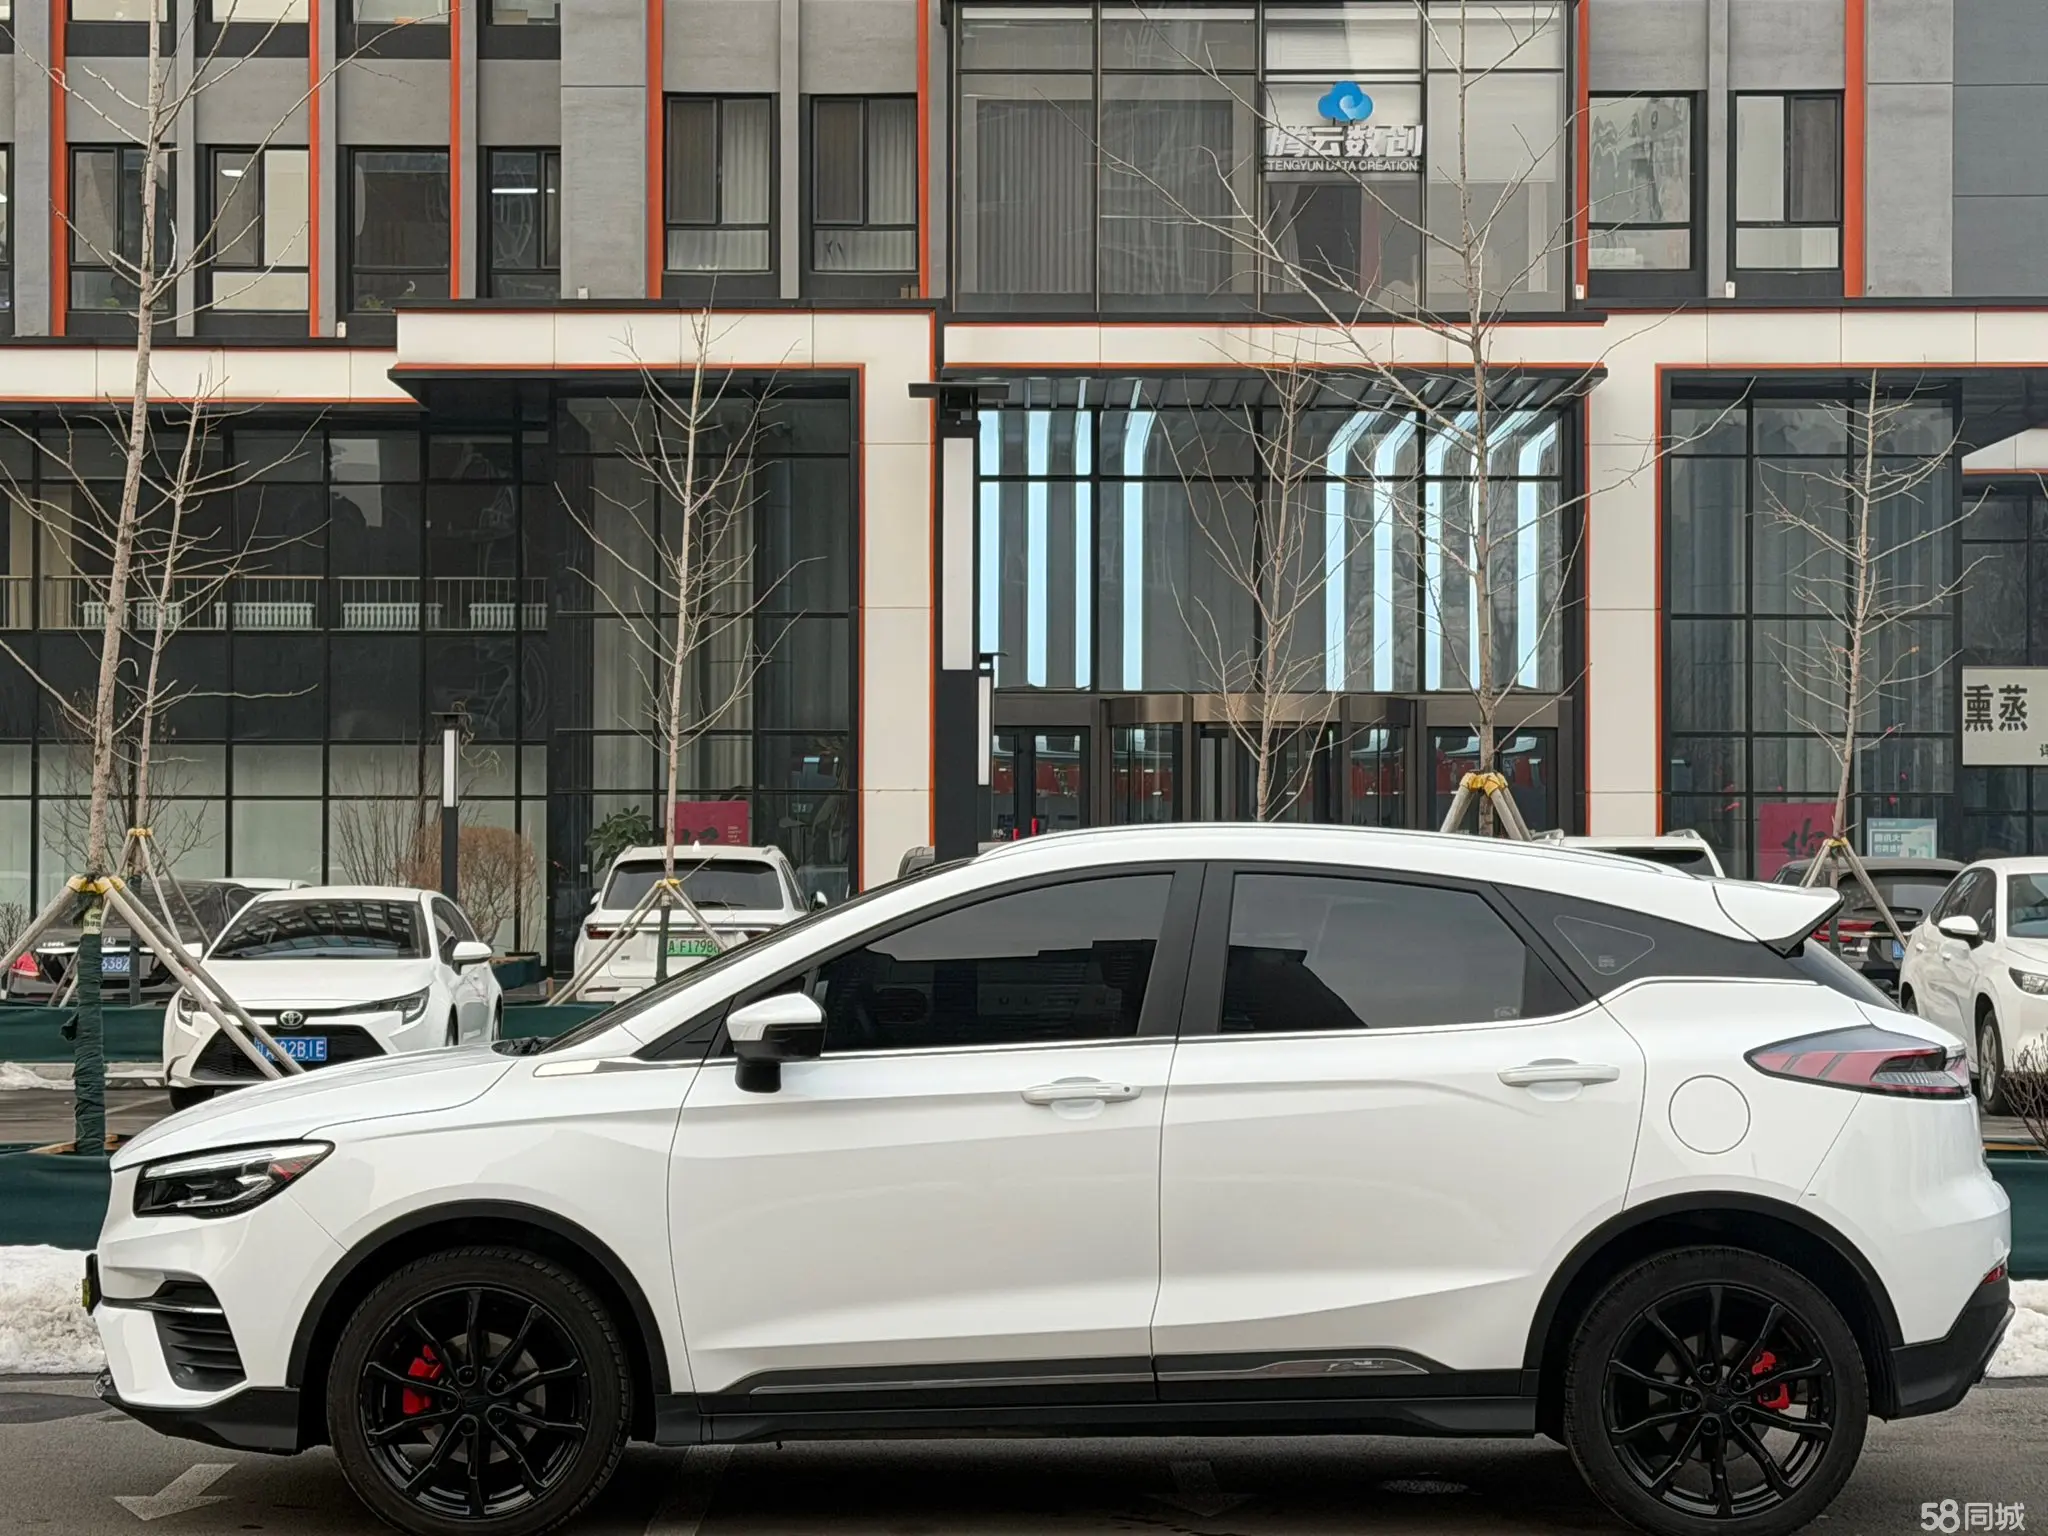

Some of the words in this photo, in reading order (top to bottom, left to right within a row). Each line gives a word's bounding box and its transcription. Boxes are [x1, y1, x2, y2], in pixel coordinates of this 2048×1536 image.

[1265, 124, 1423, 157] 腾云数创
[1267, 160, 1325, 171] TENGYUN
[1326, 160, 1357, 171] DATA
[1358, 160, 1418, 171] CREATION
[1964, 684, 2028, 732] 熏蒸
